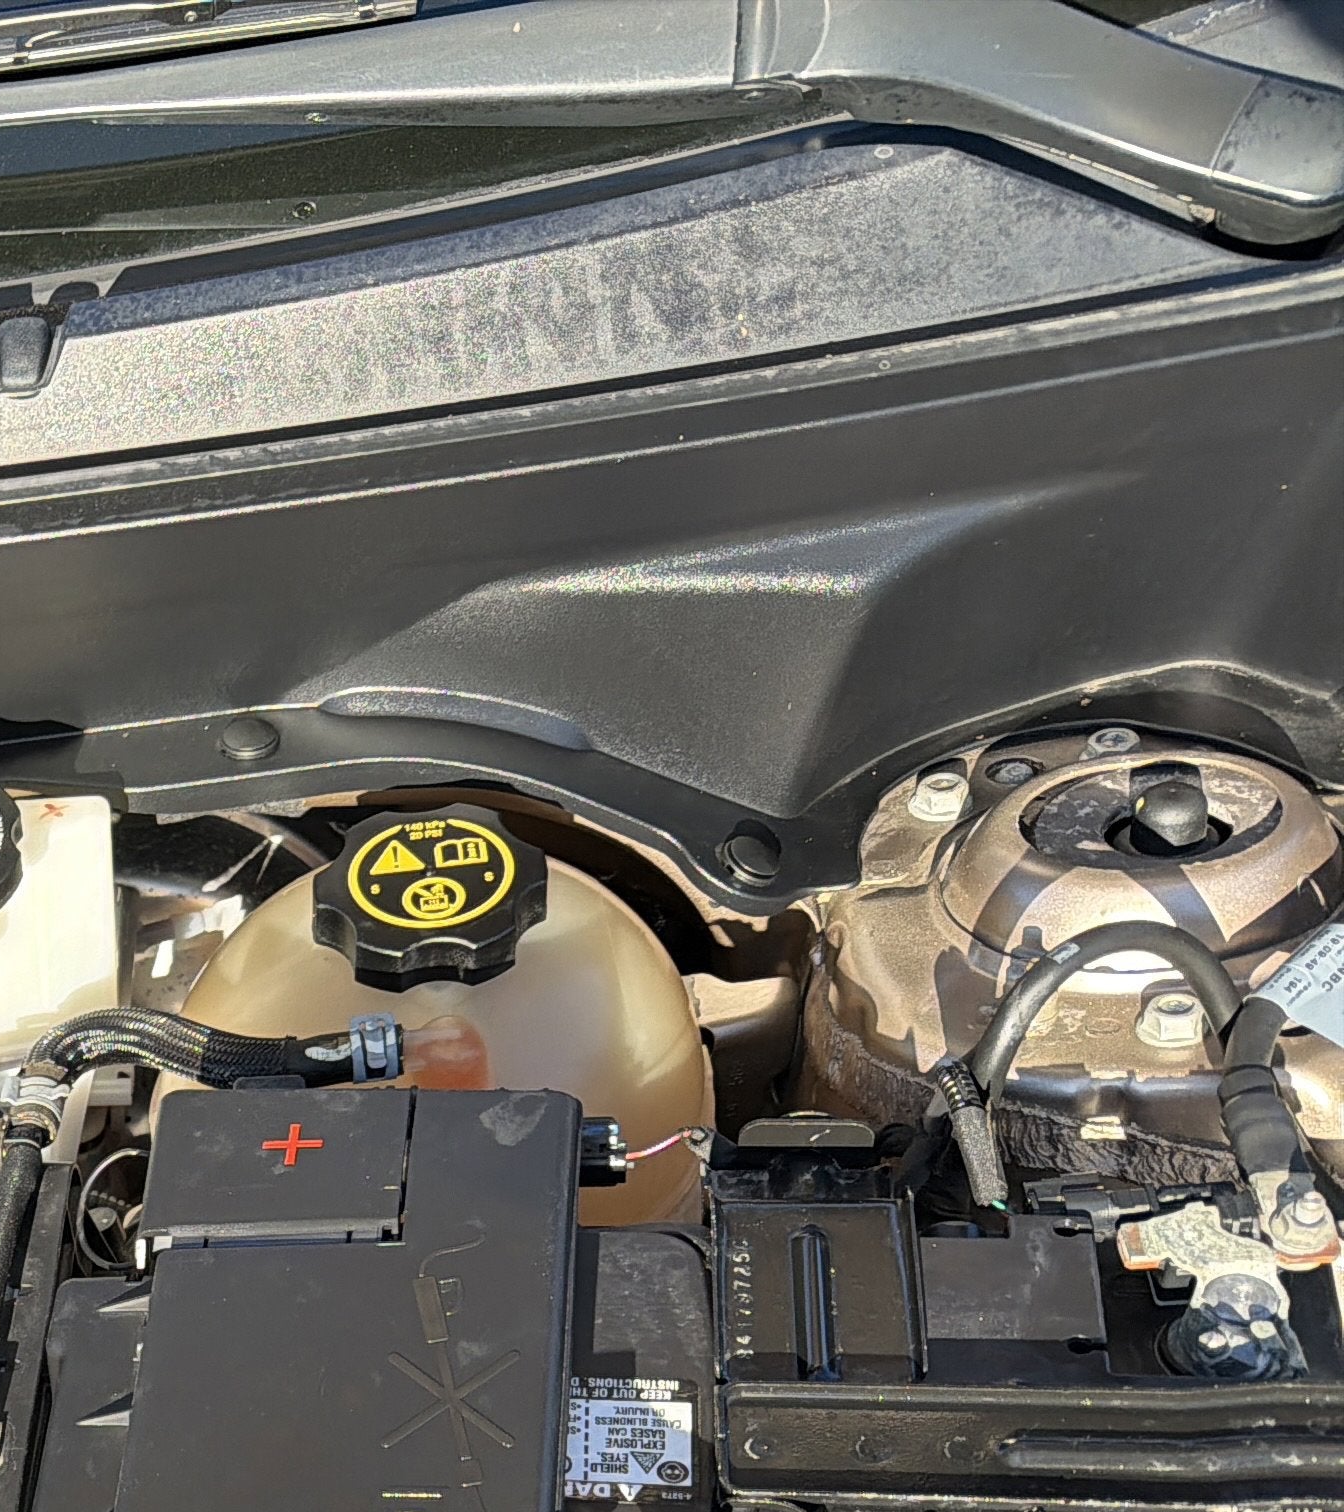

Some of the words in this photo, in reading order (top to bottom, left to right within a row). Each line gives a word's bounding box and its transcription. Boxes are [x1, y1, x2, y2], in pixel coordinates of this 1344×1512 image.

[404, 823, 423, 832] 140
[410, 831, 423, 840] 20
[425, 829, 443, 838] PSI
[584, 1377, 680, 1391] INSTRUCTIONS.
[570, 1388, 588, 1398] TH
[591, 1388, 608, 1398] OF
[612, 1389, 637, 1399] OUT
[640, 1390, 672, 1400] KEEP
[613, 1406, 650, 1416] INJURY.
[653, 1408, 666, 1416] OR
[594, 1416, 648, 1426] BLINDNESS
[651, 1418, 682, 1429] CAUSE
[607, 1427, 627, 1436] CAN
[630, 1428, 666, 1439] GASES
[605, 1437, 666, 1450] EXPLOSIVE
[596, 1451, 629, 1463] EYES.
[590, 1462, 629, 1474] SHIELD
